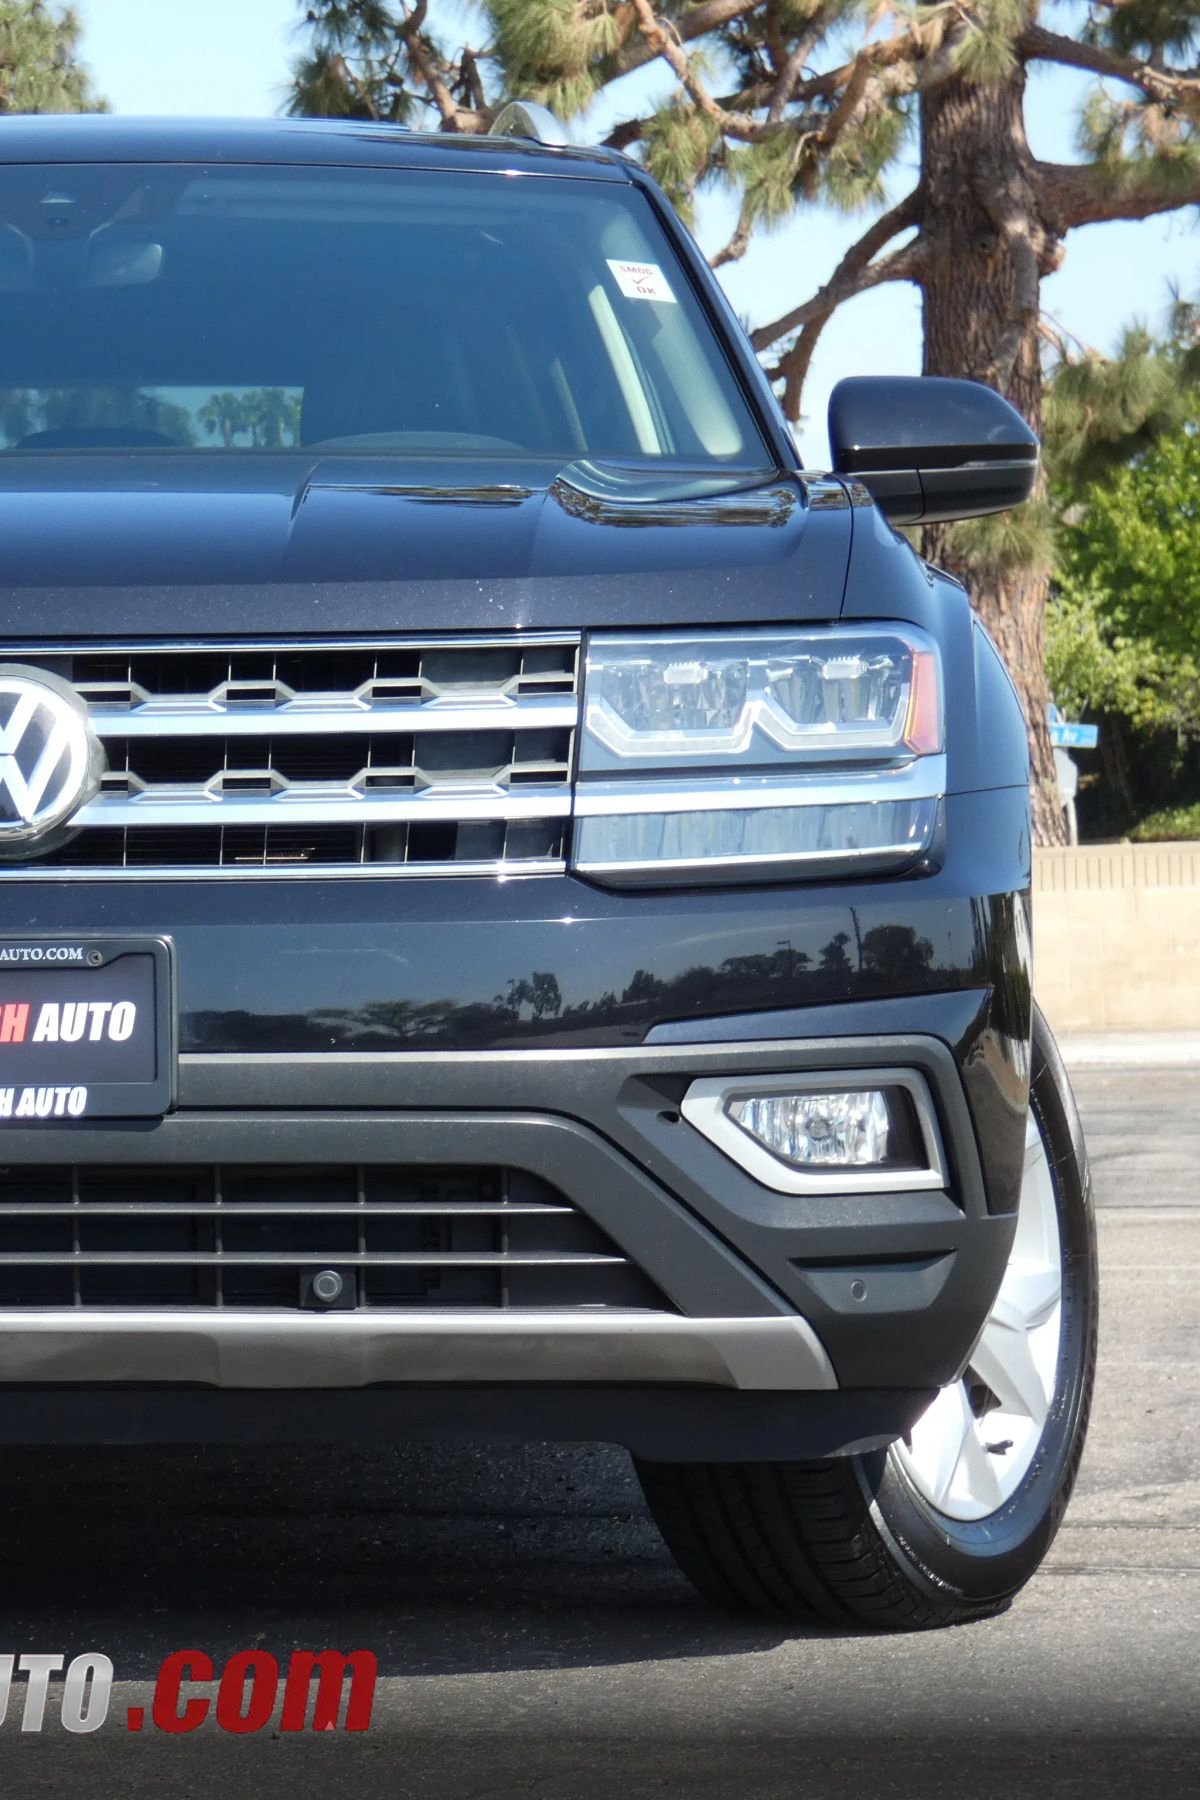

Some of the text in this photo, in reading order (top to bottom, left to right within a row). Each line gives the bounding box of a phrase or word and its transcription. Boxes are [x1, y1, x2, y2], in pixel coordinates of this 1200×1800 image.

[619, 266, 653, 275] SMOG
[636, 287, 656, 295] OK
[32, 1001, 136, 1042] AUTO
[15, 1086, 88, 1117] AUTO
